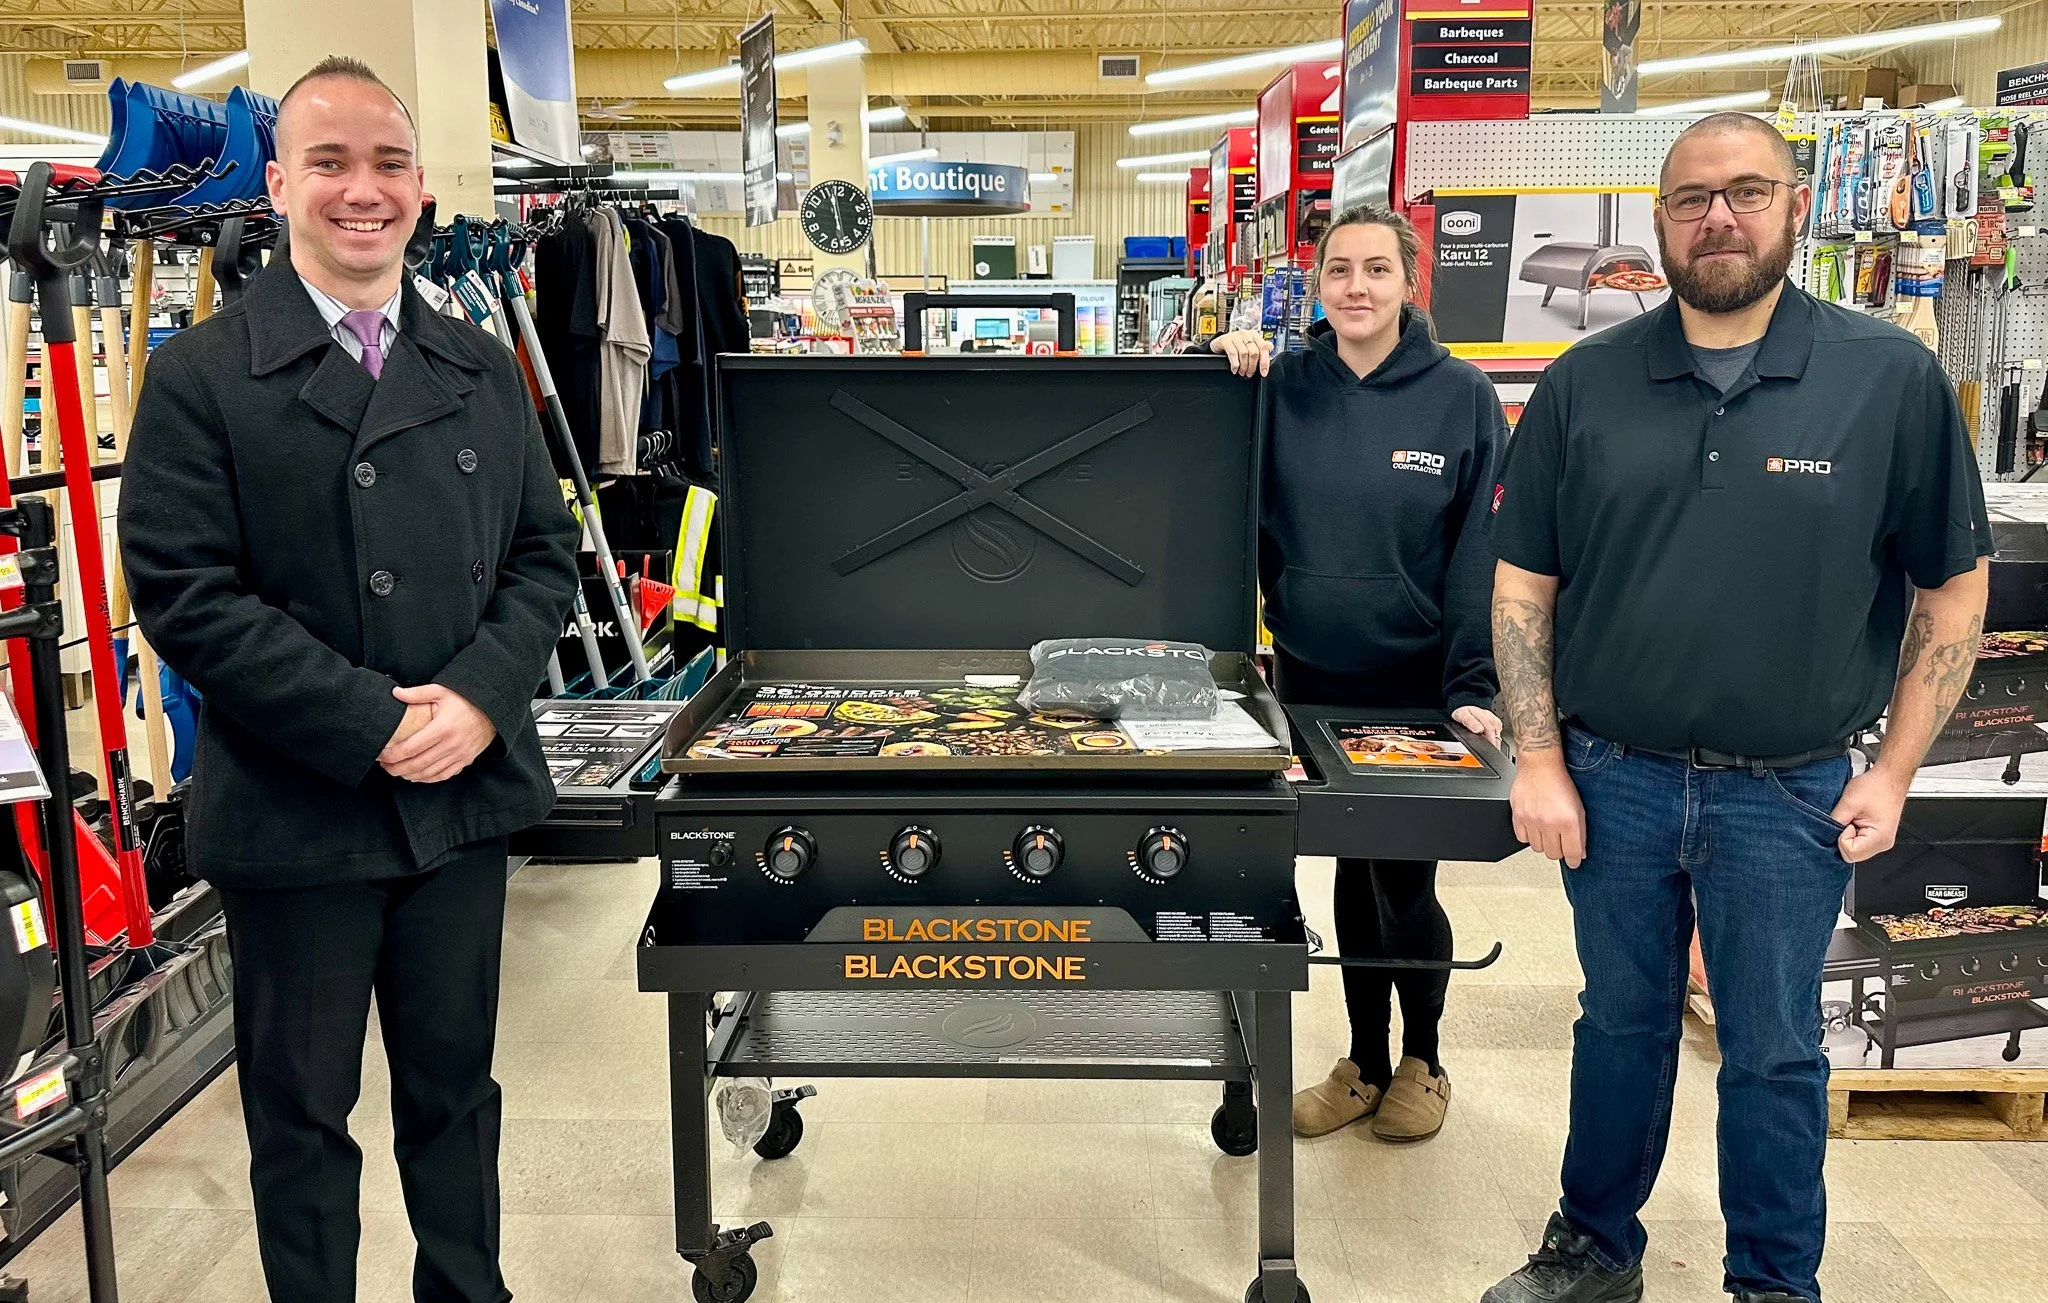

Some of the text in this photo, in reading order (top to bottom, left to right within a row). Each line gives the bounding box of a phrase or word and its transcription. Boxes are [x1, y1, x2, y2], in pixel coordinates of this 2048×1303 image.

[1440, 27, 1504, 40] Barbeques
[1444, 53, 1498, 64] Charcoal
[1320, 66, 1340, 112] 2
[1424, 77, 1518, 91] Barbeque Parts
[2001, 94, 2017, 103] HOSE
[2018, 92, 2032, 100] REEL
[1309, 126, 1339, 134] Garden
[1317, 144, 1338, 153] Sprin
[1313, 161, 1330, 169] Bird
[896, 166, 1006, 198] Boutique
[1447, 218, 1476, 228] ooni
[1440, 249, 1489, 260] Karu 12
[1406, 451, 1445, 468] PRO
[1783, 459, 1831, 474] PRO
[1392, 462, 1442, 476] CONTRACTOR
[1956, 705, 2030, 719] BLACKSTONE
[1974, 715, 2035, 727] BLACKSTONE
[117, 776, 131, 827] BENCHMARK
[670, 832, 735, 840] BLACKSTONE
[1928, 890, 1965, 898] REAR GREASE
[863, 919, 1092, 943] BLACKSTONE
[844, 955, 1086, 981] BLACKSTONE
[1953, 981, 2025, 996] BLACKSTONE
[1972, 990, 2031, 1004] BLACKSTONE
